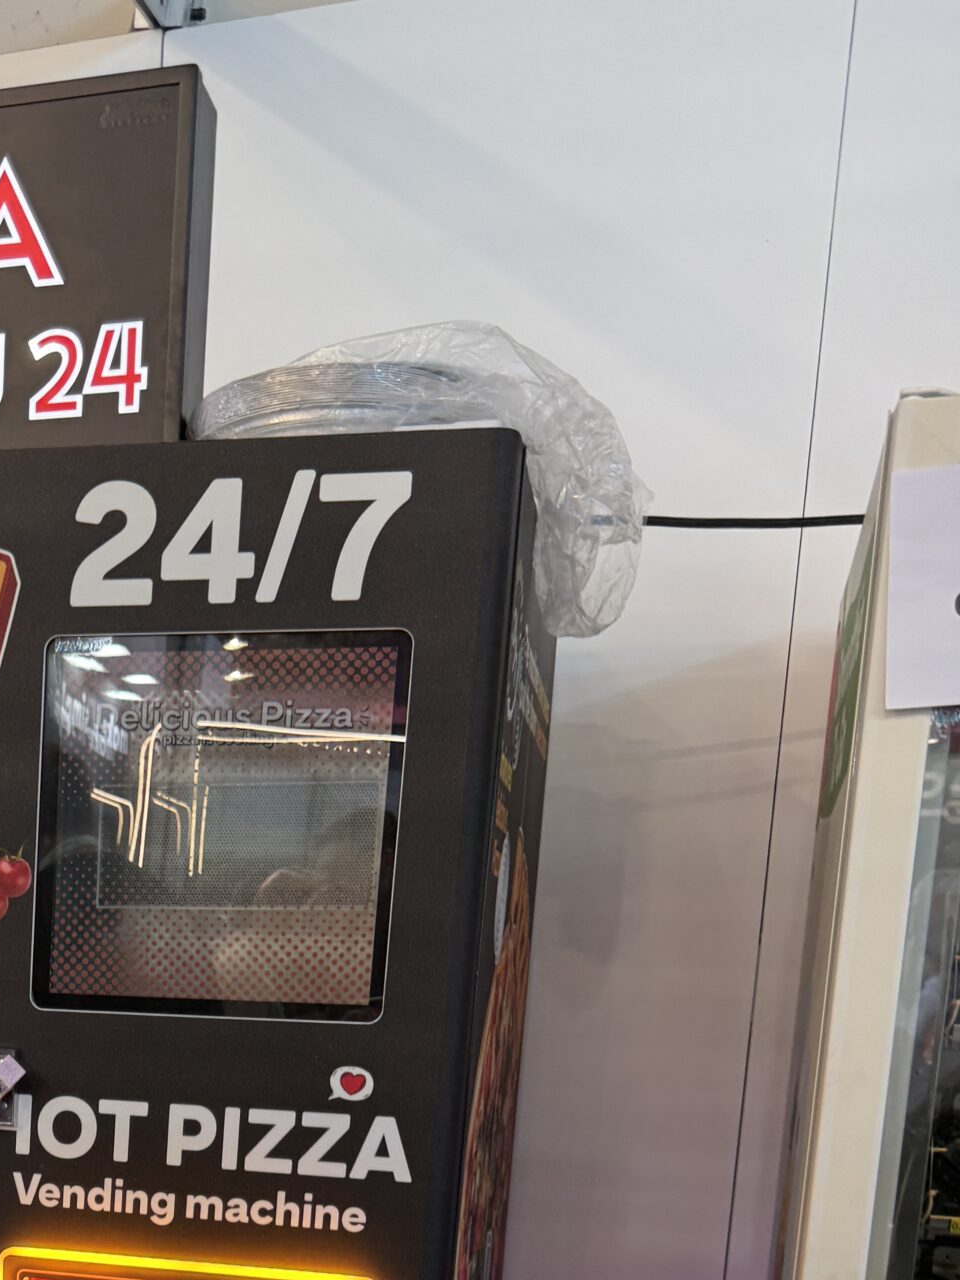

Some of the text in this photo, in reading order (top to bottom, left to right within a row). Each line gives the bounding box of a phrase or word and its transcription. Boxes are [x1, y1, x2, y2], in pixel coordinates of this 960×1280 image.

[27, 320, 148, 421] 24
[70, 469, 412, 607] 24/7
[95, 698, 253, 732] Delicious
[261, 699, 354, 730] Pizza
[166, 1105, 412, 1184] PIZZA
[12, 1171, 368, 1233] Vending machine
